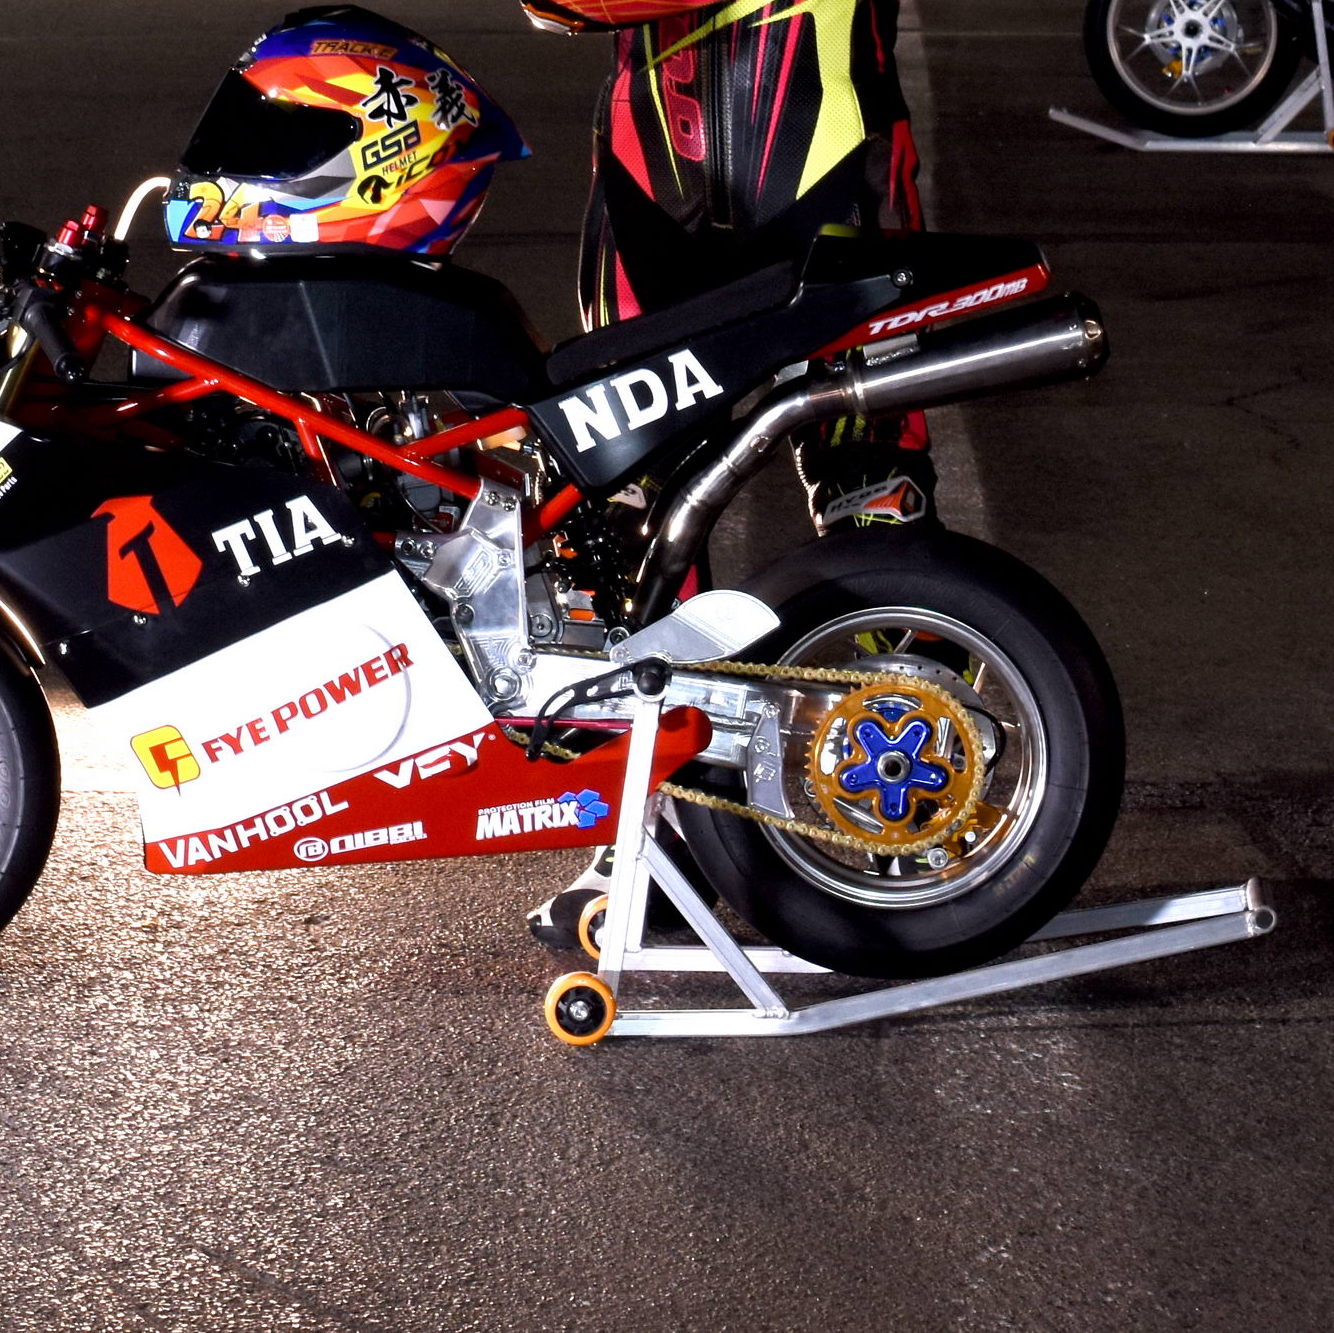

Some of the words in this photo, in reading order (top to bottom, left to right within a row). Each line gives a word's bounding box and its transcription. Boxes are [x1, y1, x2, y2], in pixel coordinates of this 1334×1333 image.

[382, 151, 418, 176] HELMET
[558, 349, 724, 454] NDA
[211, 495, 342, 577] TIA
[201, 716, 270, 765] FYE
[271, 642, 415, 737] POWER
[159, 791, 349, 869] VANHOOL
[475, 800, 581, 841] MATRIX
[478, 800, 534, 816] PROTECTION
[534, 797, 555, 809] FILM
